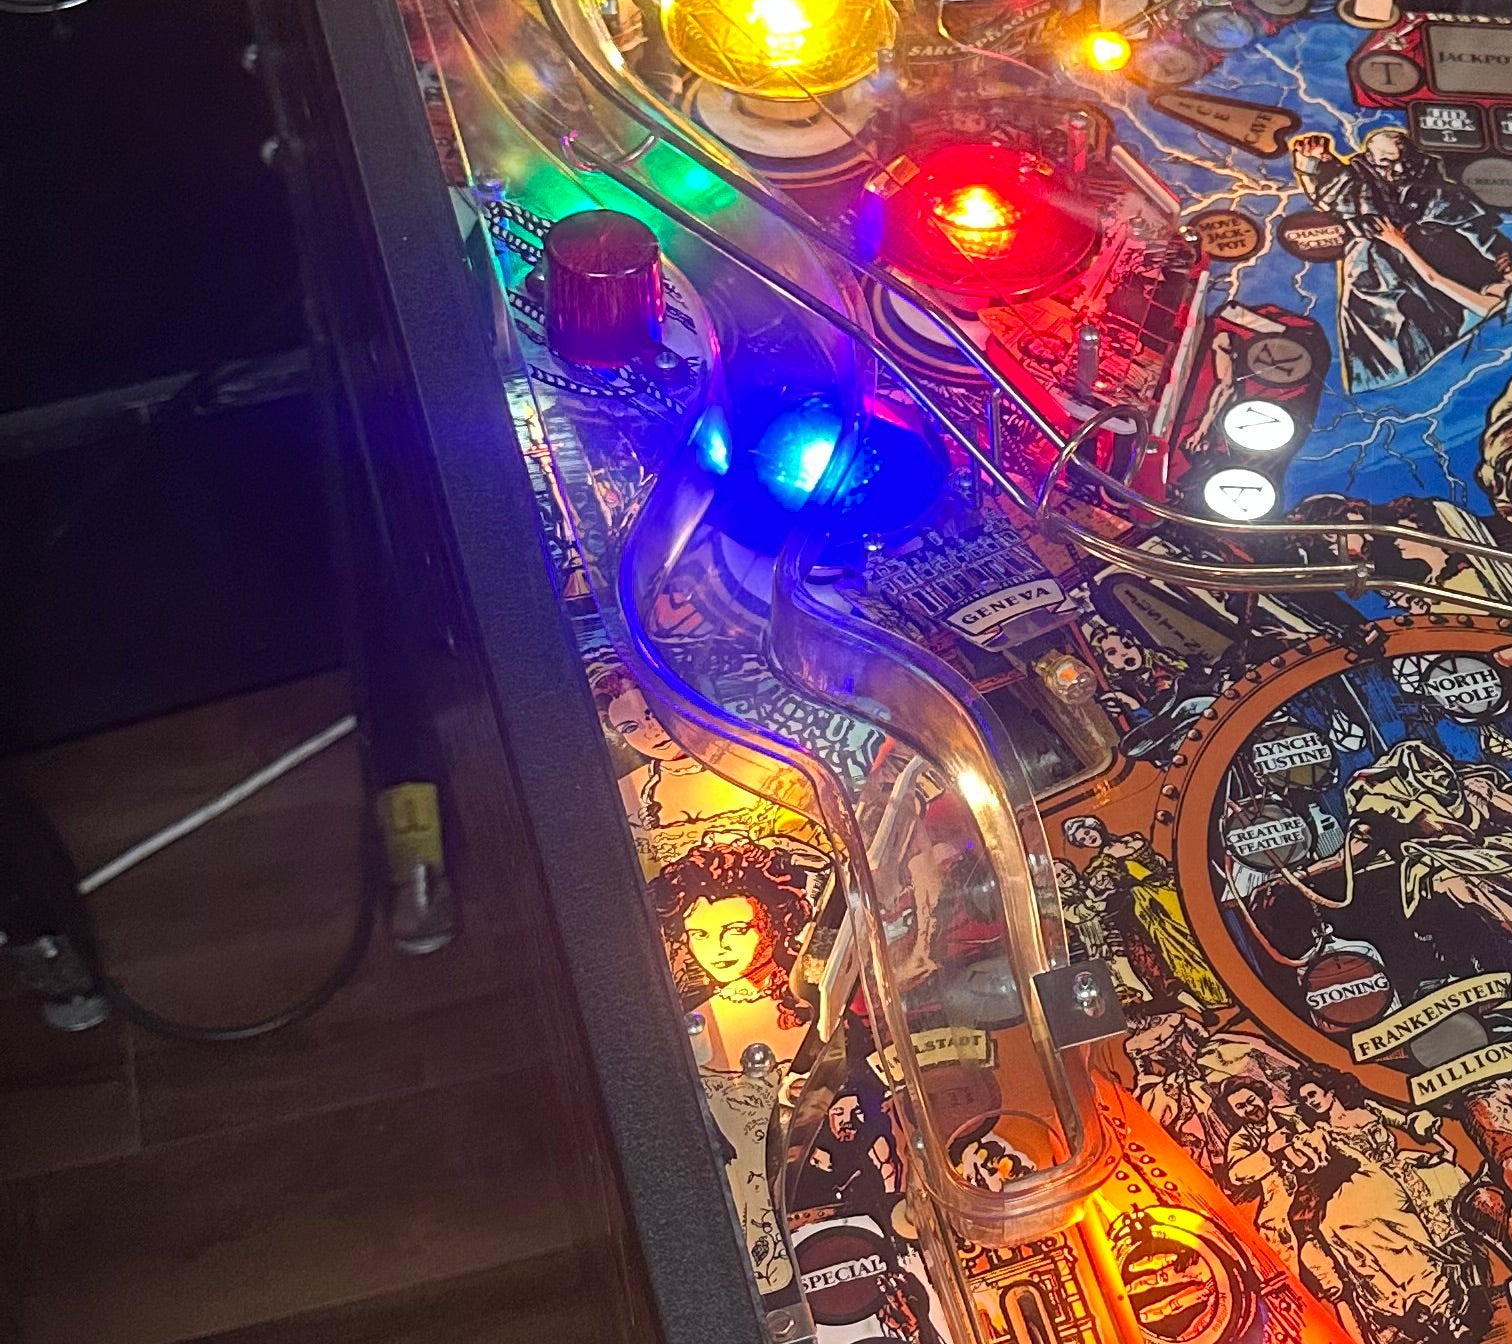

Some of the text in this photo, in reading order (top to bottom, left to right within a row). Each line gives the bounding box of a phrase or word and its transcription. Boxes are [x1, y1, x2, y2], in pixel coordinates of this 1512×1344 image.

[1373, 60, 1402, 87] T
[1420, 116, 1476, 131] LOCK
[1200, 218, 1241, 231] MOVE
[1287, 226, 1345, 240] CHANGE
[1217, 239, 1247, 252] POT
[1299, 237, 1344, 250] SCENE
[961, 586, 1052, 625] GENEVA
[1423, 668, 1498, 696] NORTH
[1445, 685, 1499, 708] POLE
[1255, 733, 1319, 759] LYNCH
[1255, 747, 1331, 774] JUSTINE
[1227, 818, 1304, 845] CREATURE
[1238, 832, 1304, 855] FEATURE
[1307, 975, 1388, 1009] STONING
[1357, 978, 1510, 1057] FRANKENSTEIN
[800, 1258, 886, 1291] SPECIAL
